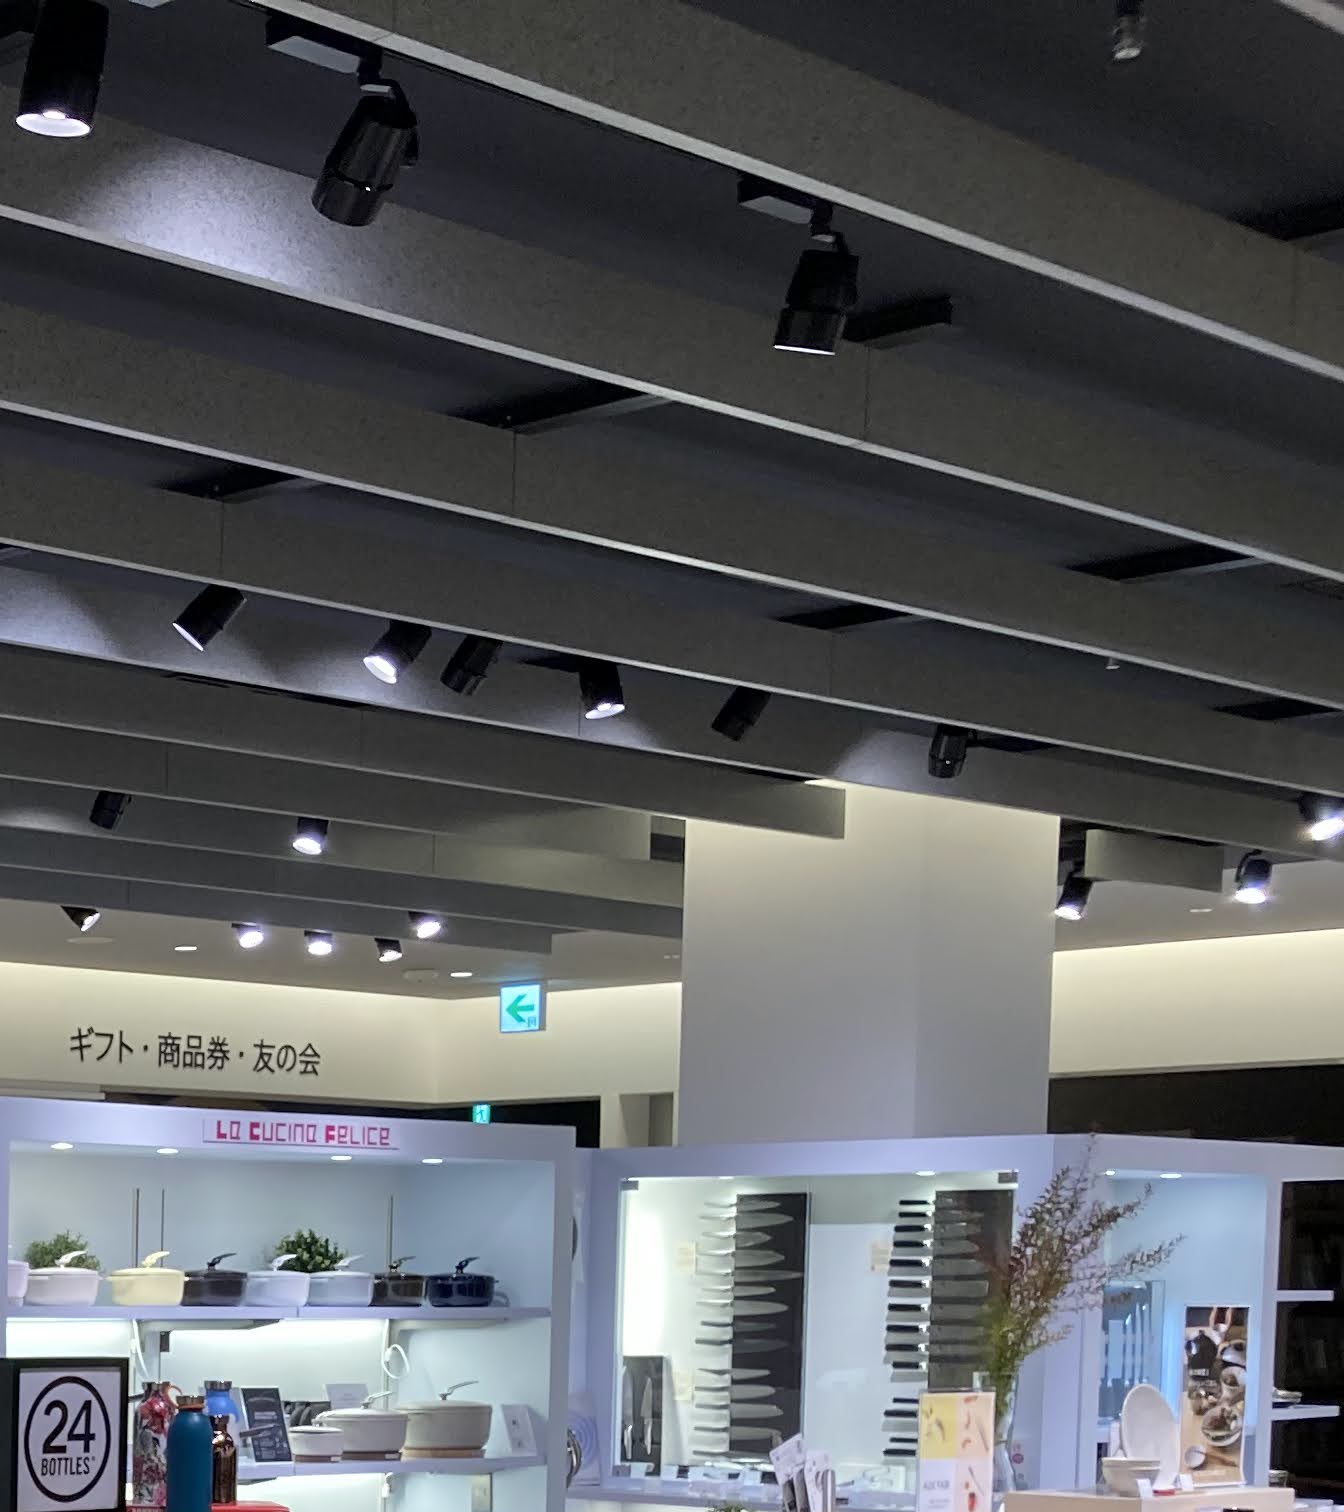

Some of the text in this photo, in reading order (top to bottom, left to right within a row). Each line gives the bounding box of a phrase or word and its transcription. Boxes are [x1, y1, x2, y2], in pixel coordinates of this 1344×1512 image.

[69, 1026, 322, 1077] ギフト・商品券・友の会
[42, 1399, 96, 1454] 24
